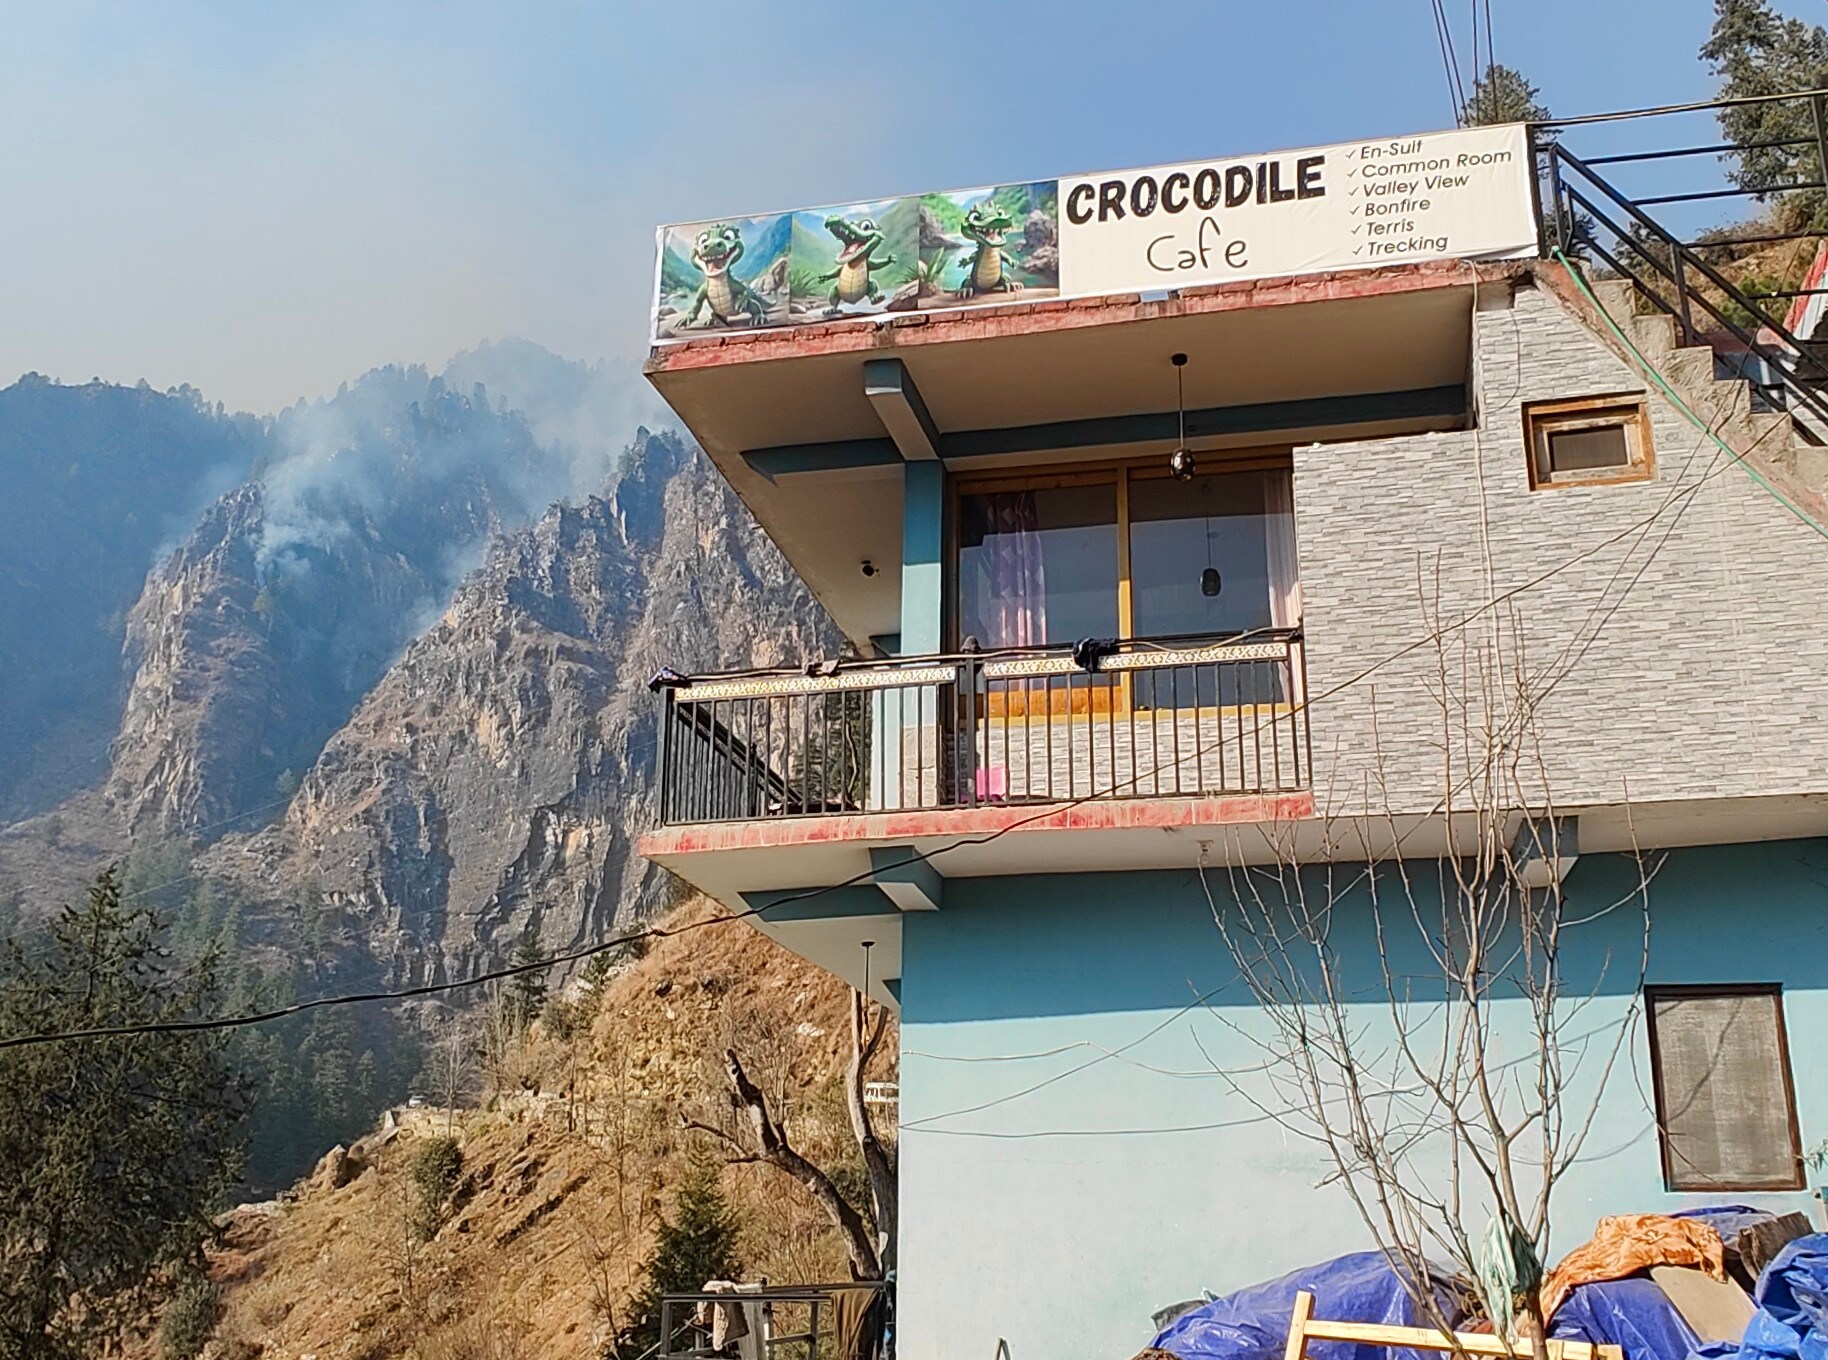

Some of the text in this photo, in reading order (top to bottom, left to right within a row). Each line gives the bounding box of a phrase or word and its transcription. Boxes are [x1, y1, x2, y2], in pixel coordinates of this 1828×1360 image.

[1361, 151, 1512, 178] Common Room
[1066, 155, 1326, 225] CROCODILE
[1363, 174, 1470, 197] Valley View
[1365, 198, 1431, 216] Bonfire
[1366, 218, 1415, 236] Terris
[1146, 216, 1249, 272] Cafe
[1368, 236, 1449, 256] Trecking
